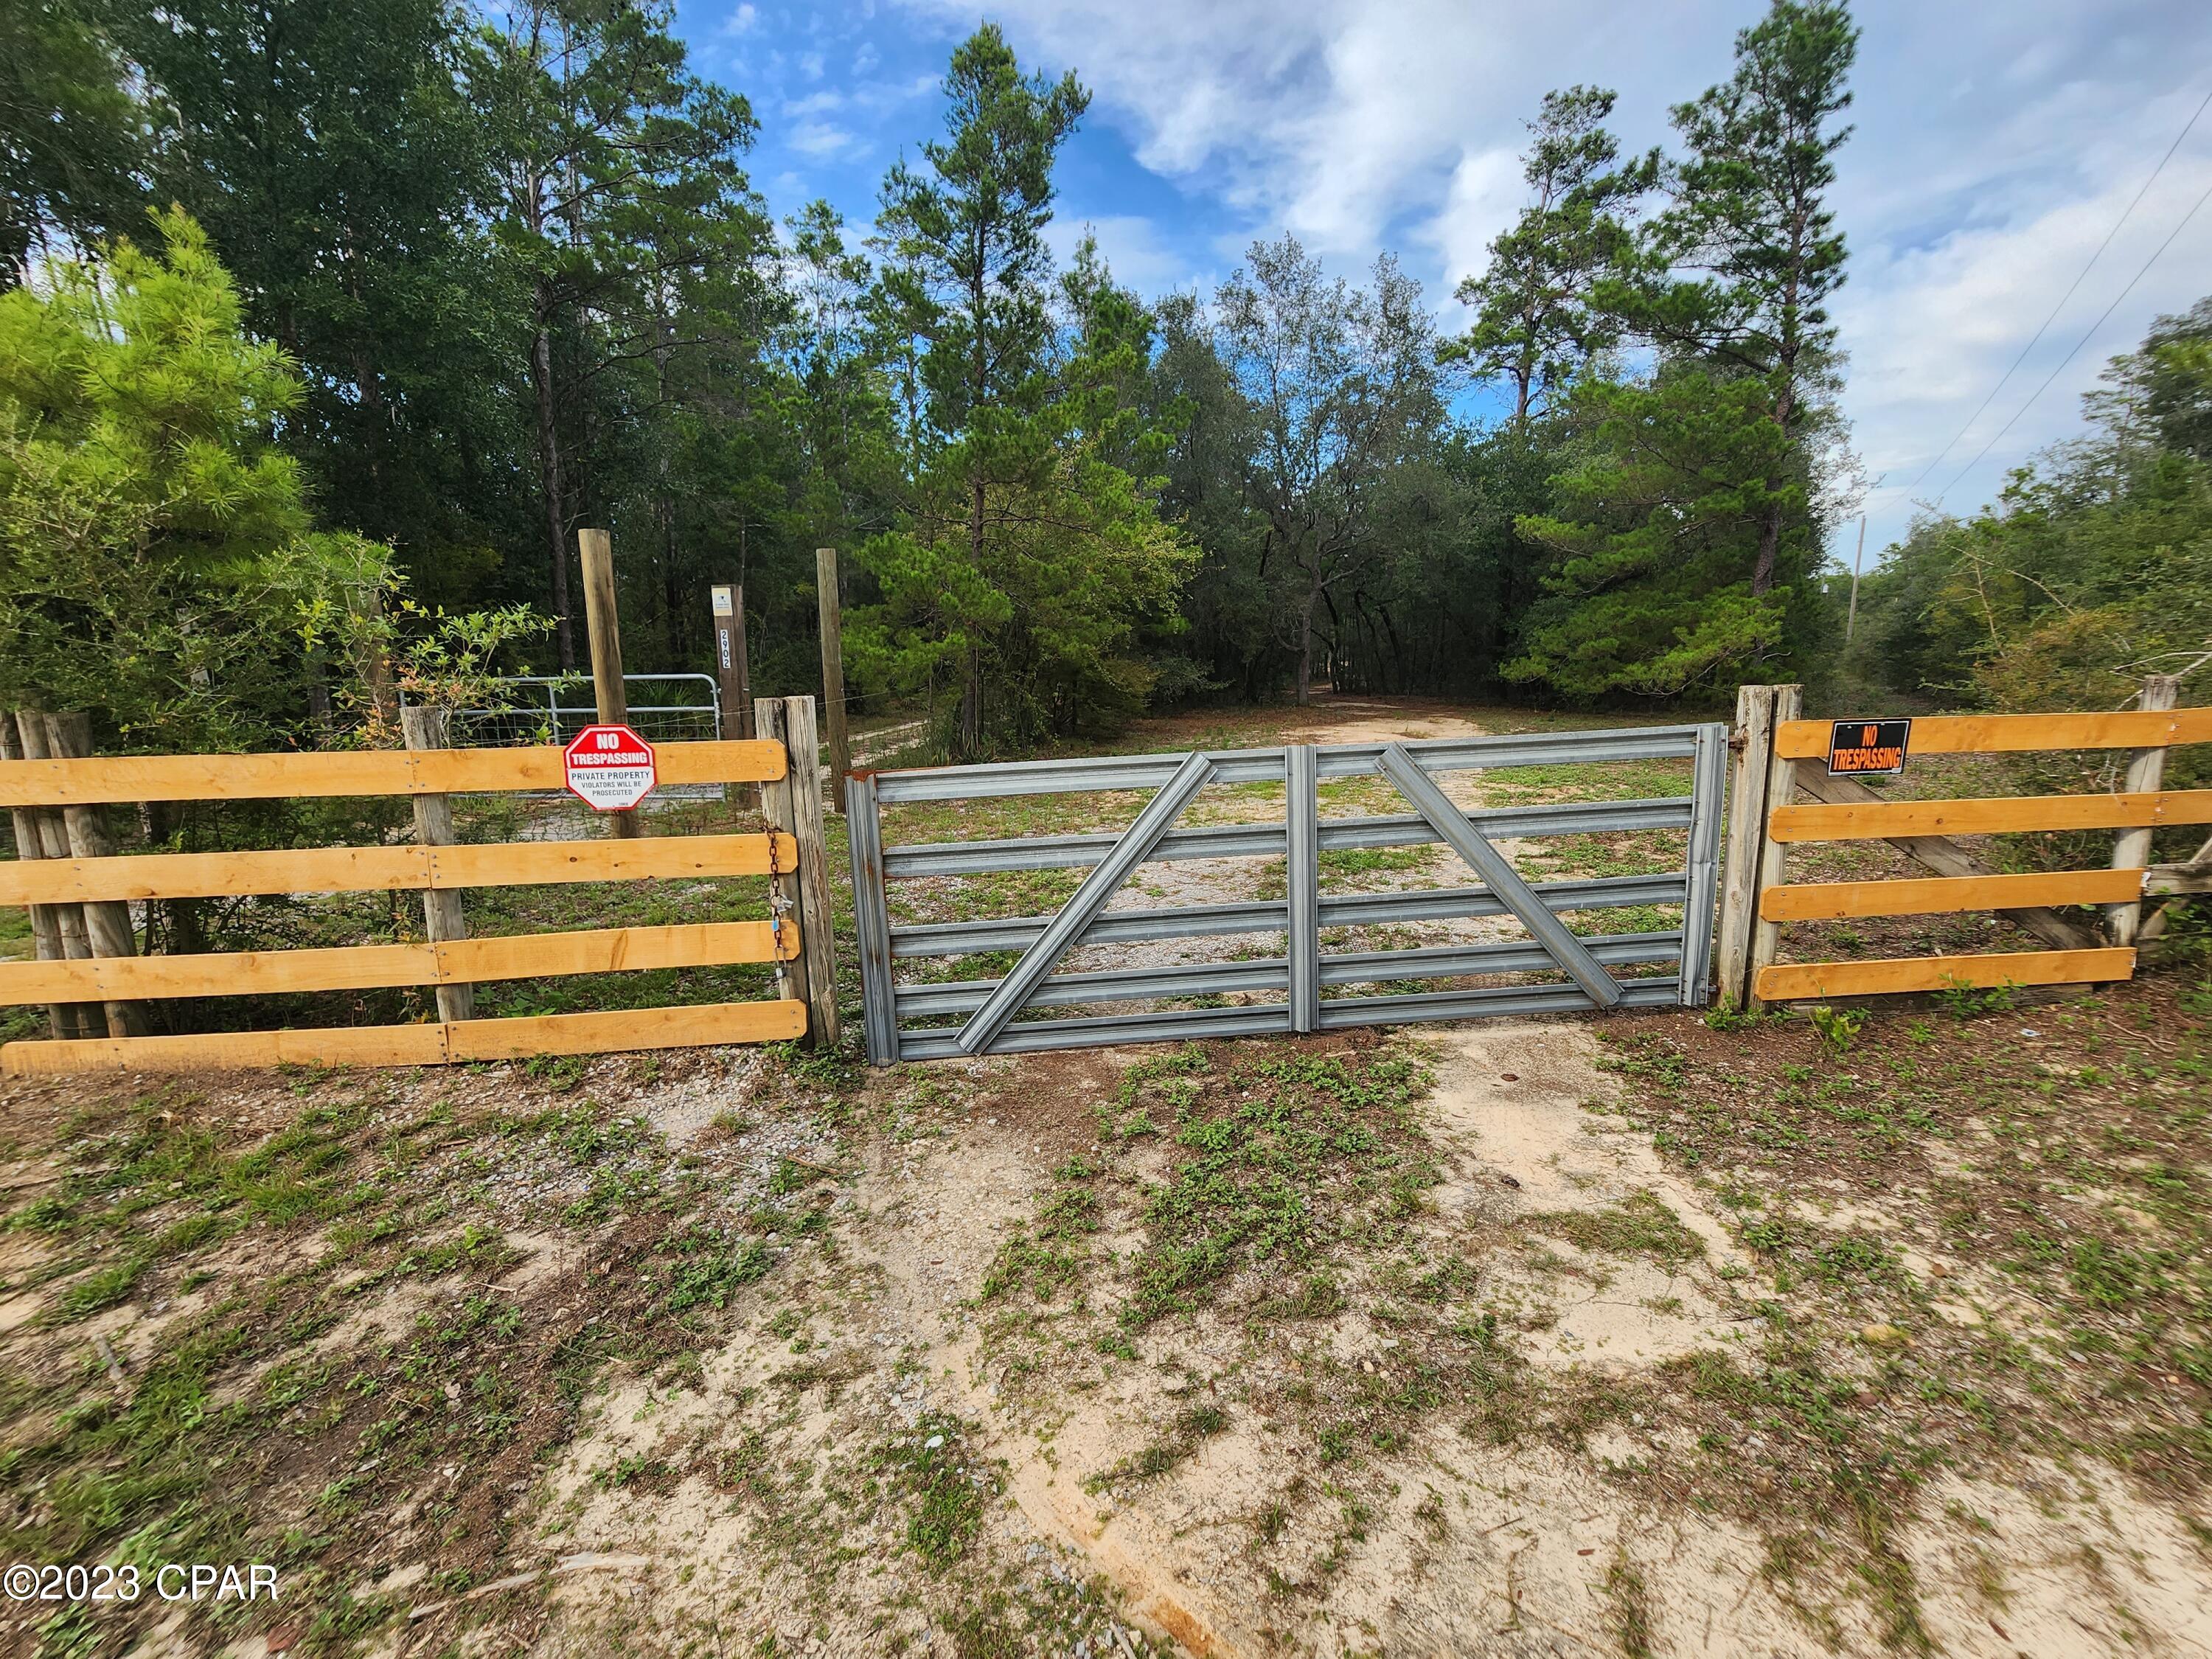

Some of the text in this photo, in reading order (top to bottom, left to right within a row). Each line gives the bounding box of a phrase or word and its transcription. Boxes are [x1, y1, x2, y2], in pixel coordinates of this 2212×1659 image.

[721, 630, 729, 667] 2902
[597, 733, 619, 750] NO
[1863, 726, 1877, 746] NO
[571, 752, 647, 765] TRESPASSING
[1833, 747, 1901, 770] TRESPASSING
[571, 771, 650, 780] PRIVATE PROPERTY
